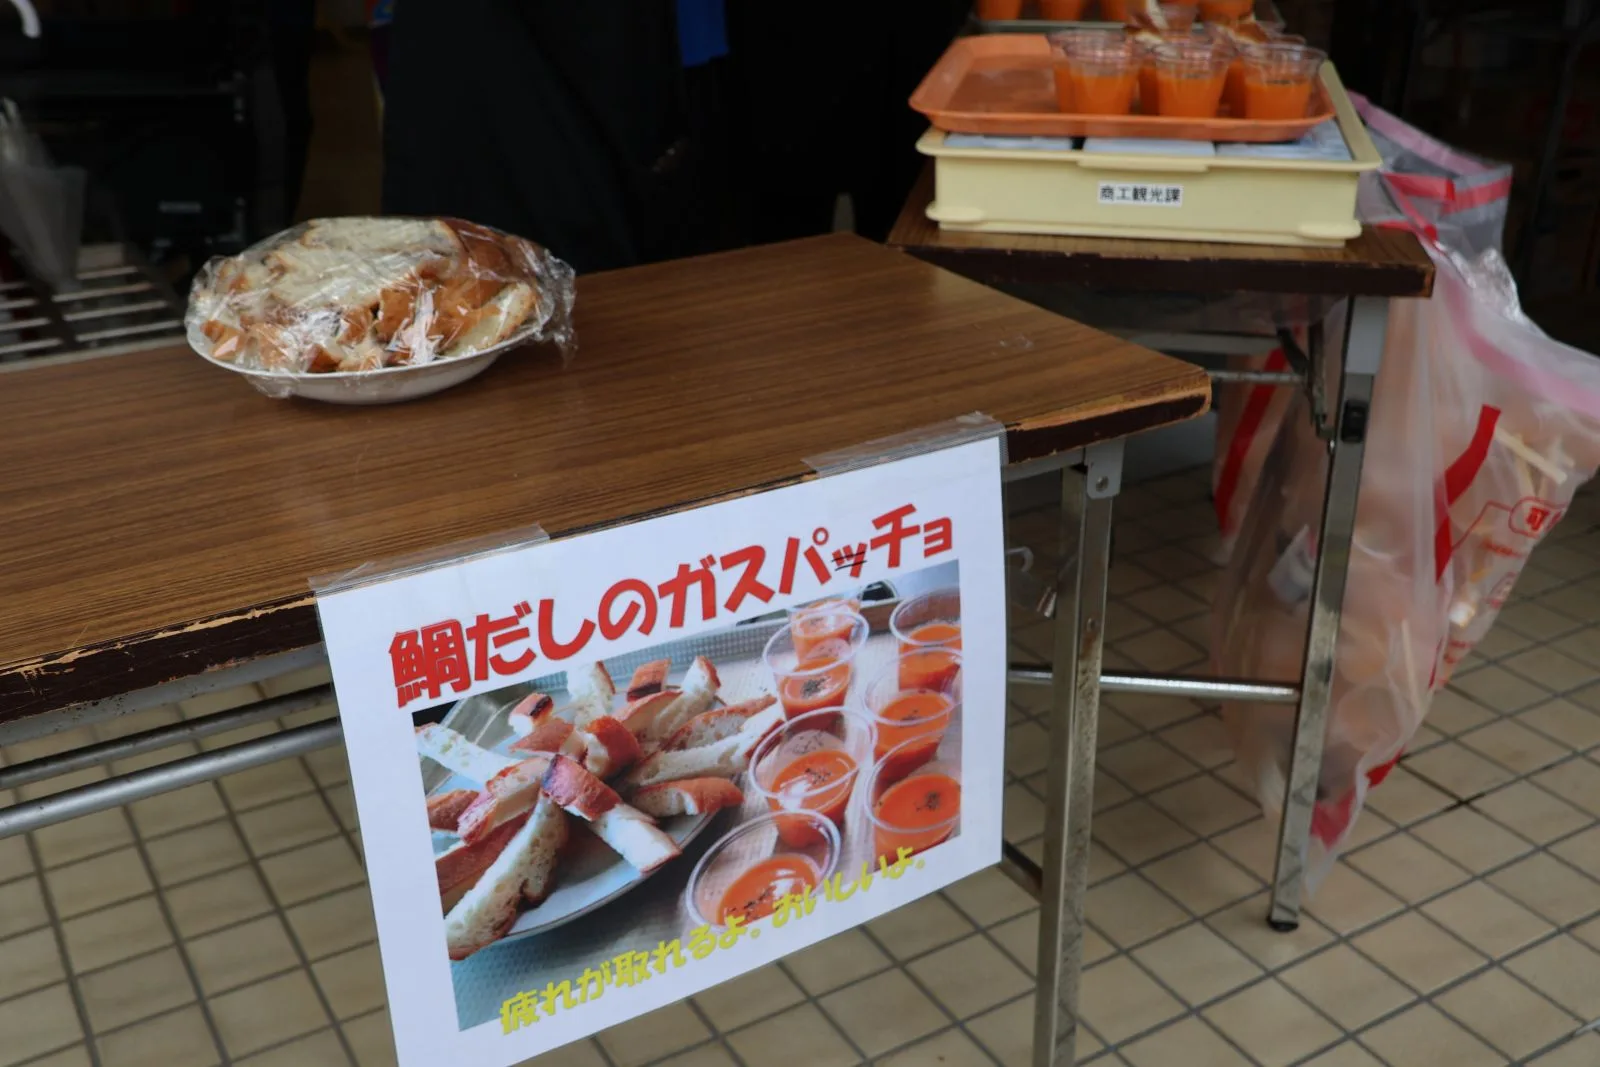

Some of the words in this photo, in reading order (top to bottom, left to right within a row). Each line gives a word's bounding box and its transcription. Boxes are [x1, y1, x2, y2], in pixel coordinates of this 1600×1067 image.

[1101, 185, 1181, 203] 商工観光課
[388, 503, 953, 708] 鯛だしのガスパッチョ
